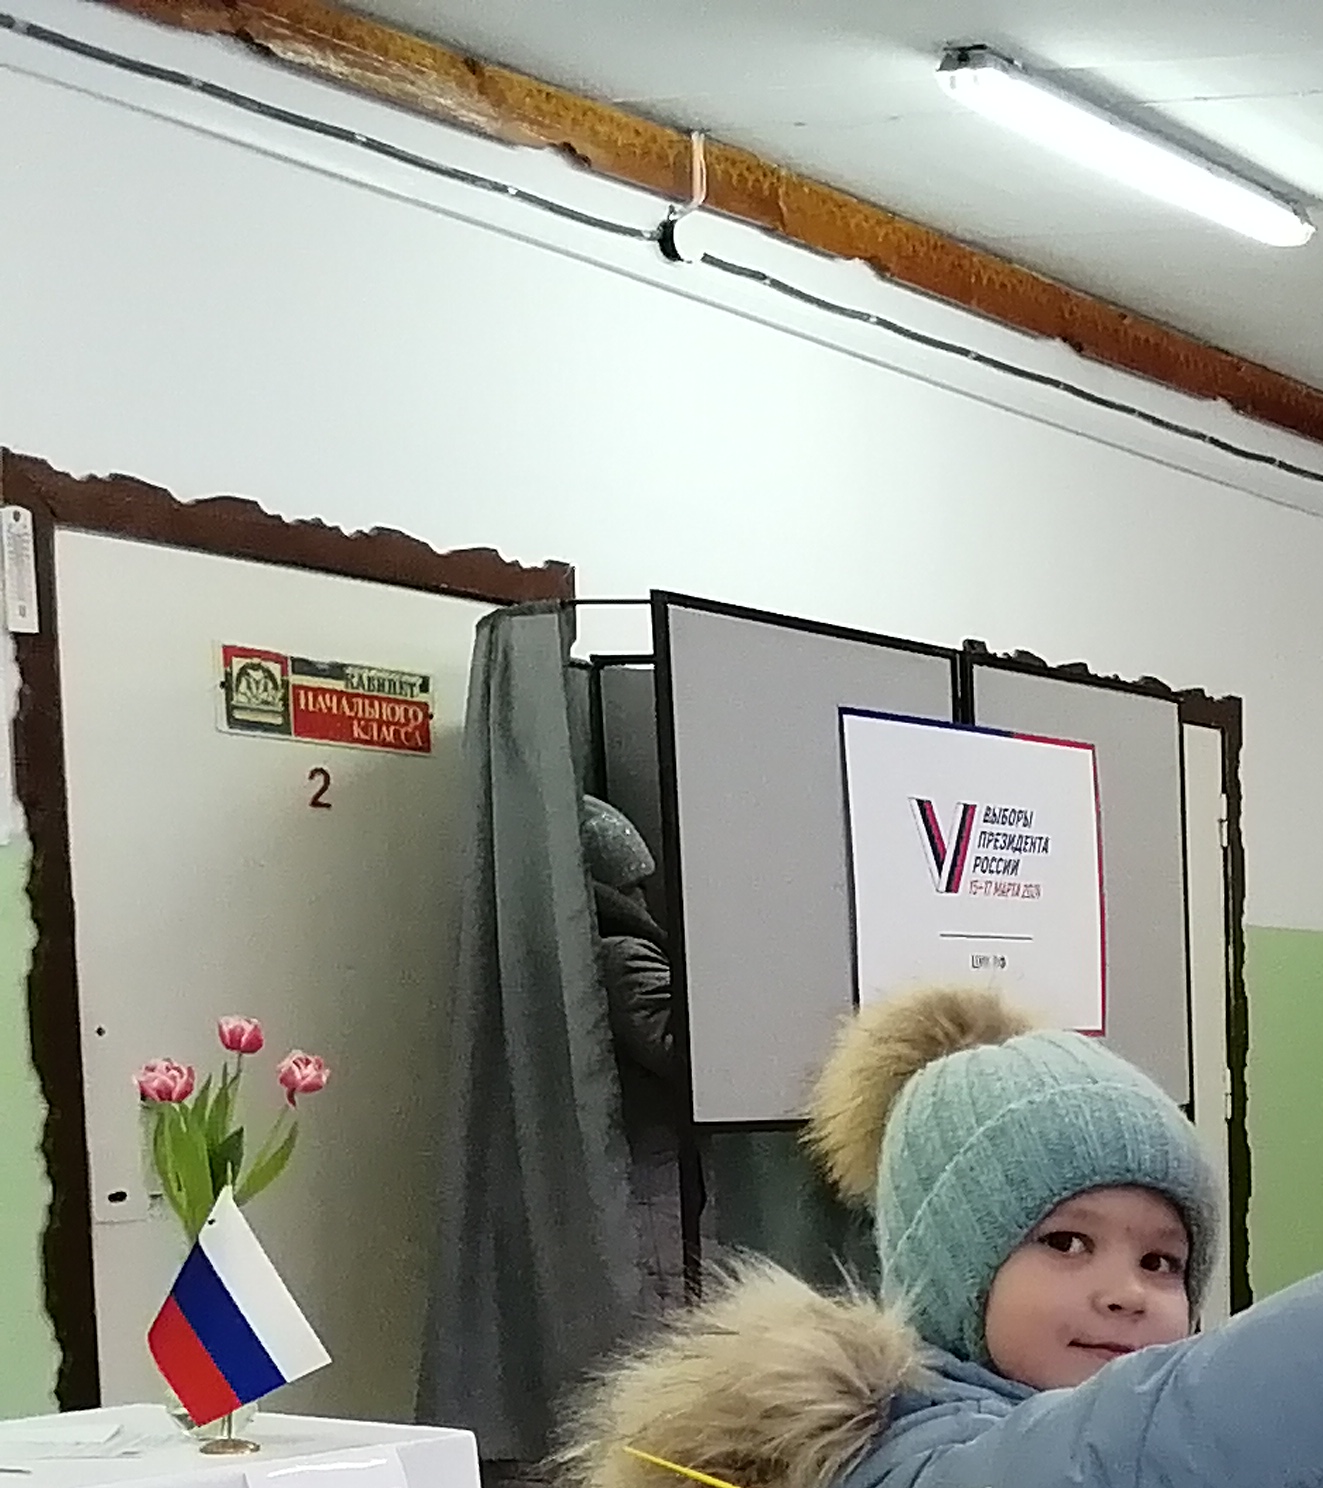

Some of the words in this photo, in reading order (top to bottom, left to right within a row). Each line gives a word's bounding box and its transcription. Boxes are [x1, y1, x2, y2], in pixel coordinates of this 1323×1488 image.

[298, 690, 424, 724] НАЧАЛЬНОГО
[352, 721, 424, 747] КЛАССА
[308, 767, 332, 808] 2
[983, 805, 1033, 828] ВЫБОРЫ
[978, 830, 1050, 854] ПРЕЗИДЕНТА
[973, 856, 1020, 876] РОССИИ
